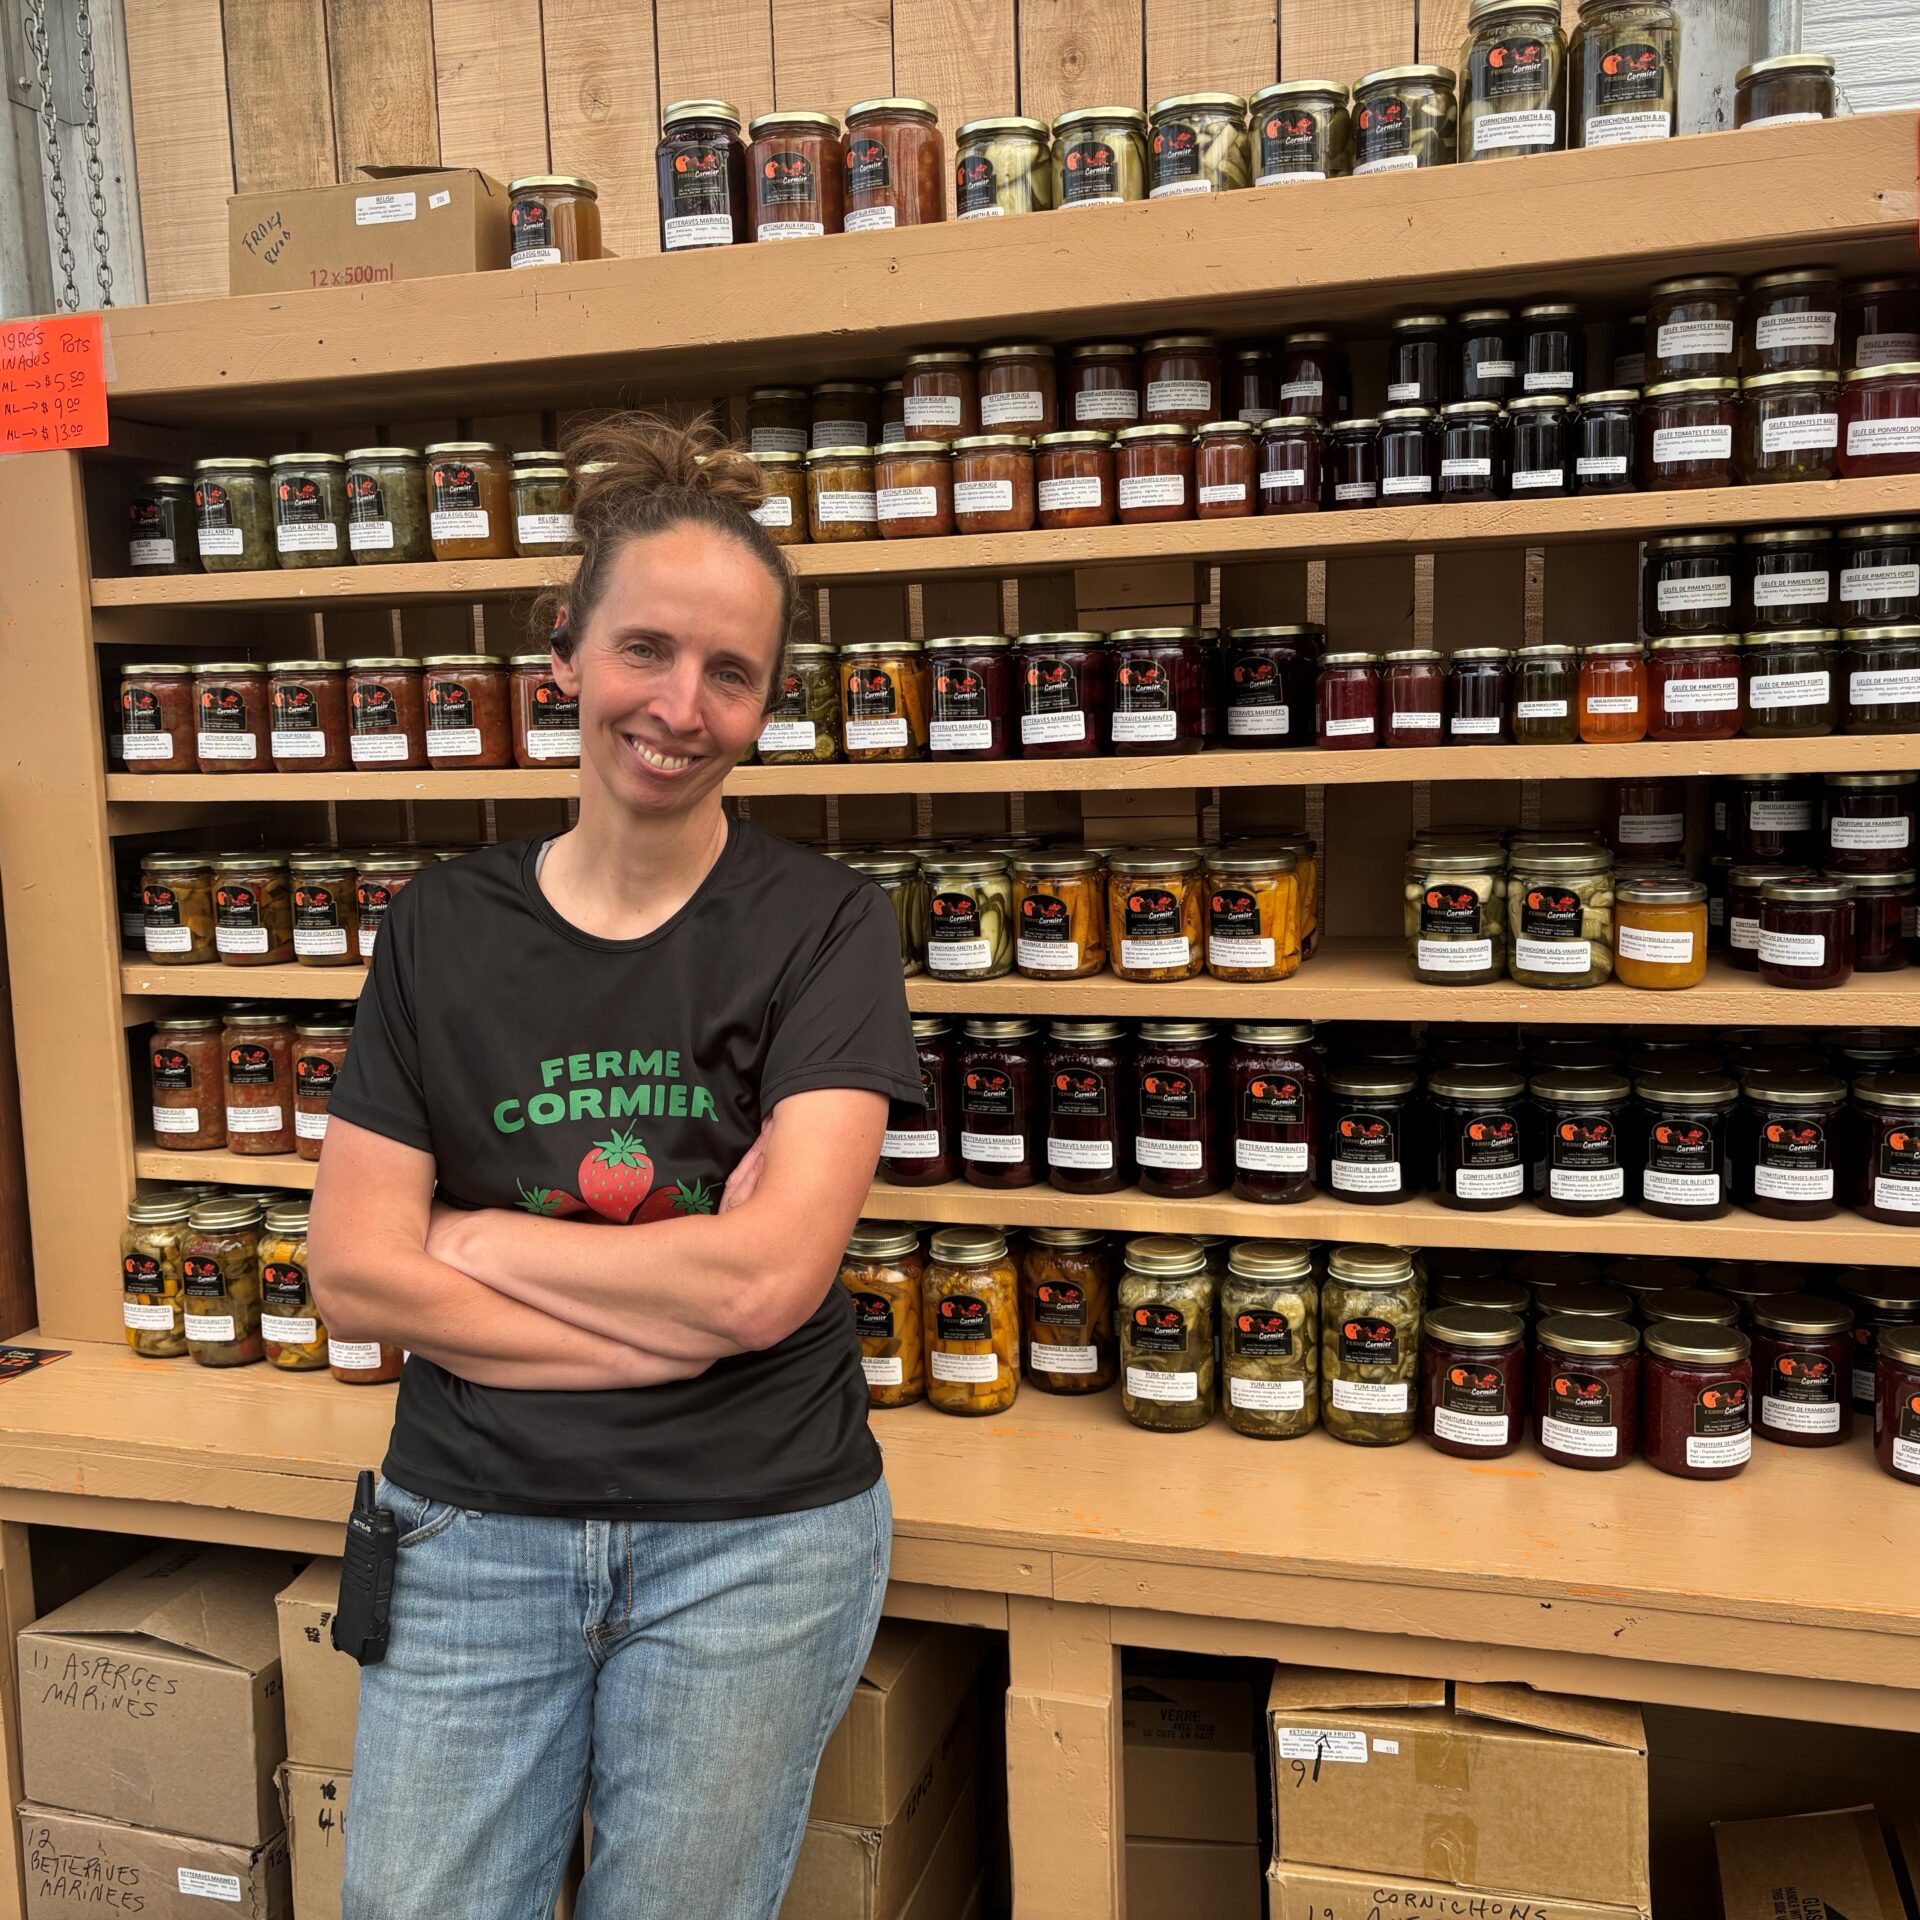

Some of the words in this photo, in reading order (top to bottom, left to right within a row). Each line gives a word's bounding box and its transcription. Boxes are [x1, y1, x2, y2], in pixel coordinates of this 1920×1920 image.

[1591, 118, 1627, 128] CORNICHONS
[1631, 116, 1651, 124] ANETH
[1376, 122, 1402, 133] Cormier
[1285, 135, 1312, 144] Cormier
[1168, 149, 1191, 158] Cormier
[859, 162, 881, 173] Cormier
[1085, 166, 1110, 175] Cormier
[783, 176, 807, 184] Cormier
[968, 179, 989, 189] Cormier
[667, 219, 698, 228] BETTERAVES
[310, 270, 328, 287] 12
[332, 273, 340, 285] x
[344, 263, 394, 284] 500ml
[1778, 317, 1804, 325] TOMATES
[1658, 431, 1672, 439] GELÉE
[1675, 429, 1702, 437] TOMATES
[1846, 573, 1861, 581] GELÉE
[1663, 585, 1677, 593] GELÉE
[1044, 682, 1068, 692] Cormier
[1136, 684, 1160, 692] Cormier
[865, 690, 888, 699] Cormier
[954, 691, 977, 700] Cormier
[288, 706, 310, 714] Cormier
[1446, 908, 1473, 918] Cormier
[1547, 910, 1575, 920] Cormier
[540, 1050, 680, 1087] FERME
[493, 1085, 719, 1133] CORMIER
[909, 1133, 936, 1141] MARINÉES
[963, 1134, 992, 1143] BETTERAVES
[993, 1136, 1021, 1144] MARINÉES
[1049, 1141, 1079, 1149] BETTERAVES
[1080, 1142, 1109, 1150] MARINÉES
[1138, 1140, 1168, 1150] BETTERAVES
[1169, 1142, 1198, 1151] MARINÉES
[1239, 1143, 1274, 1152] BETTERAVES
[1275, 1145, 1305, 1153] MARINÉES
[1583, 1139, 1609, 1149] Cormier
[1677, 1144, 1705, 1153] Cormier
[1789, 1143, 1817, 1152] Cormier
[1336, 1164, 1362, 1172] CONFITURE
[1558, 1173, 1588, 1181] CONFITURE
[1599, 1172, 1620, 1180] BLEUETS
[1650, 1175, 1678, 1183] CONFITURE
[1760, 1171, 1786, 1180] CONFITURE
[1145, 1372, 1175, 1380] YUM-YUM
[1251, 1381, 1281, 1389] YUM-YUM
[1801, 1377, 1829, 1385] Cormier
[1354, 1383, 1386, 1392] YUM-YUM
[1471, 1387, 1499, 1397] Cormier
[1768, 1402, 1796, 1411] CONFITURE
[1439, 1412, 1464, 1423] CONFITURE
[1473, 1419, 1504, 1427] FRAMBOISES
[63, 1653, 179, 1695] ASPERGES
[1160, 1709, 1200, 1723] VERRE
[28, 1829, 56, 1854] 12
[31, 1850, 139, 1886] BETTERAVES
[180, 1870, 210, 1880] BETTERAVES
[211, 1875, 237, 1885] MARINÉES
